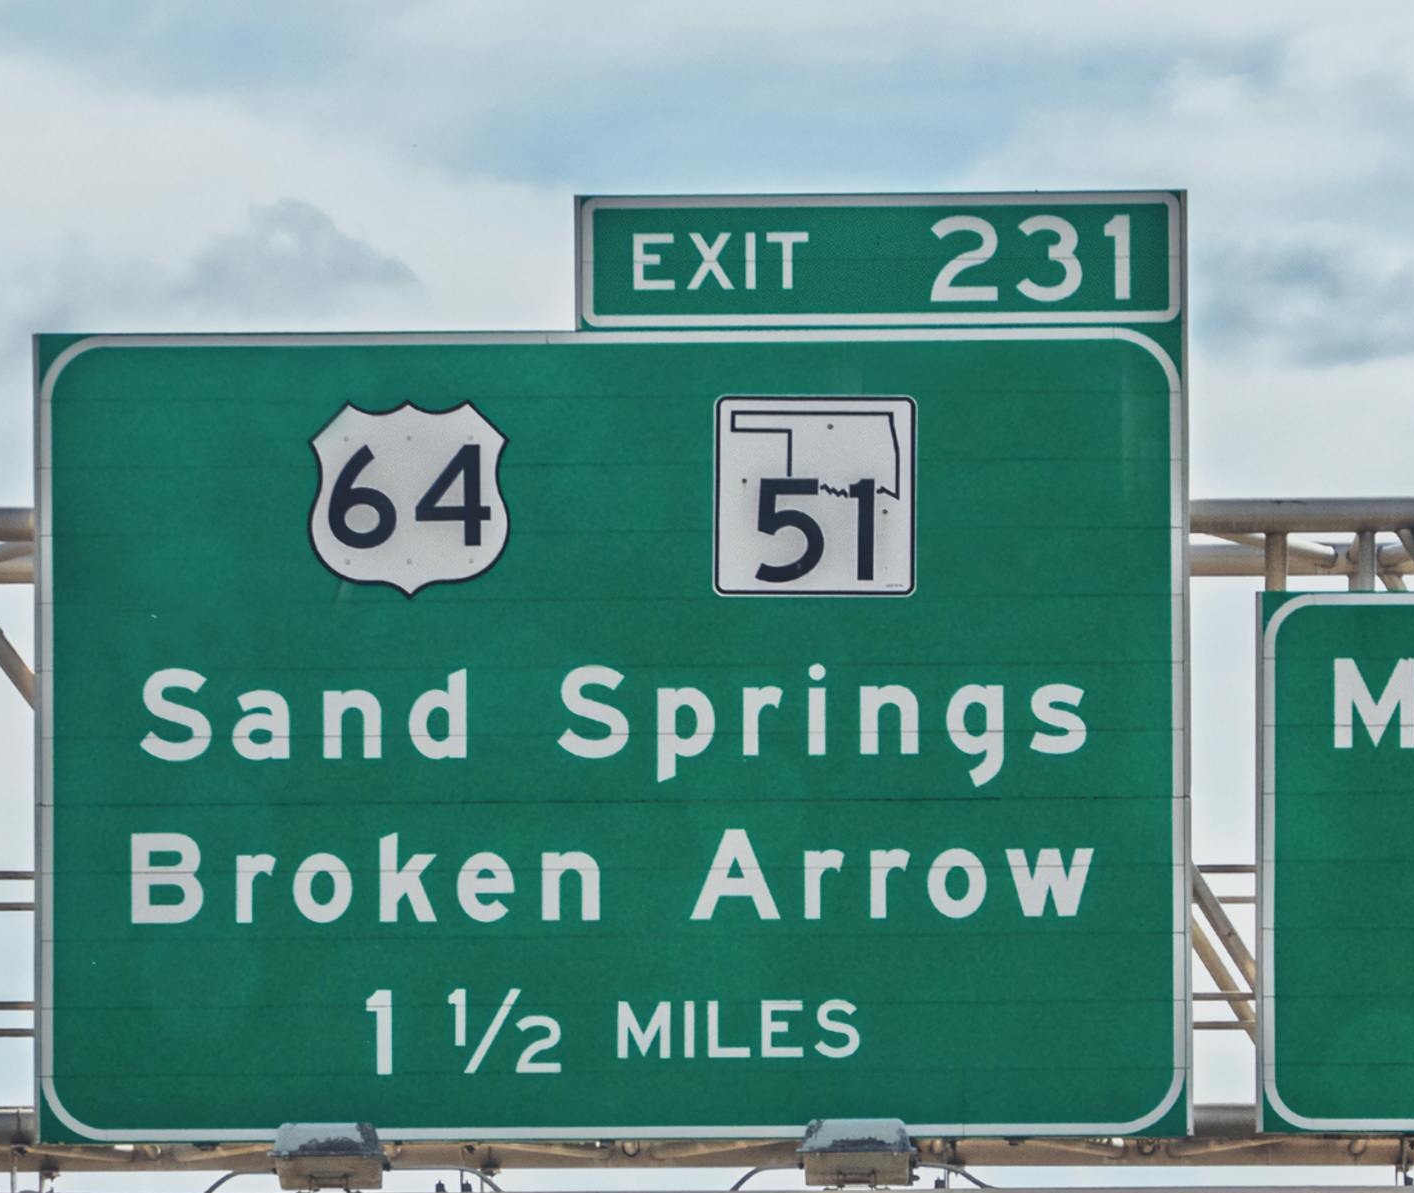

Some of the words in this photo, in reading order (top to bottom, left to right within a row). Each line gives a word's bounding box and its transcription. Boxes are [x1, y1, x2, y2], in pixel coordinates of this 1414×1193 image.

[633, 232, 809, 290] EXIT
[930, 215, 1130, 302] 231
[328, 444, 491, 549] 64
[755, 478, 875, 583] 51
[140, 668, 467, 761] Sand
[557, 663, 1087, 787] Springs
[131, 832, 600, 924] Broken
[690, 828, 1094, 920] Arrow
[366, 989, 392, 1075] 1
[617, 999, 860, 1058] MILES
